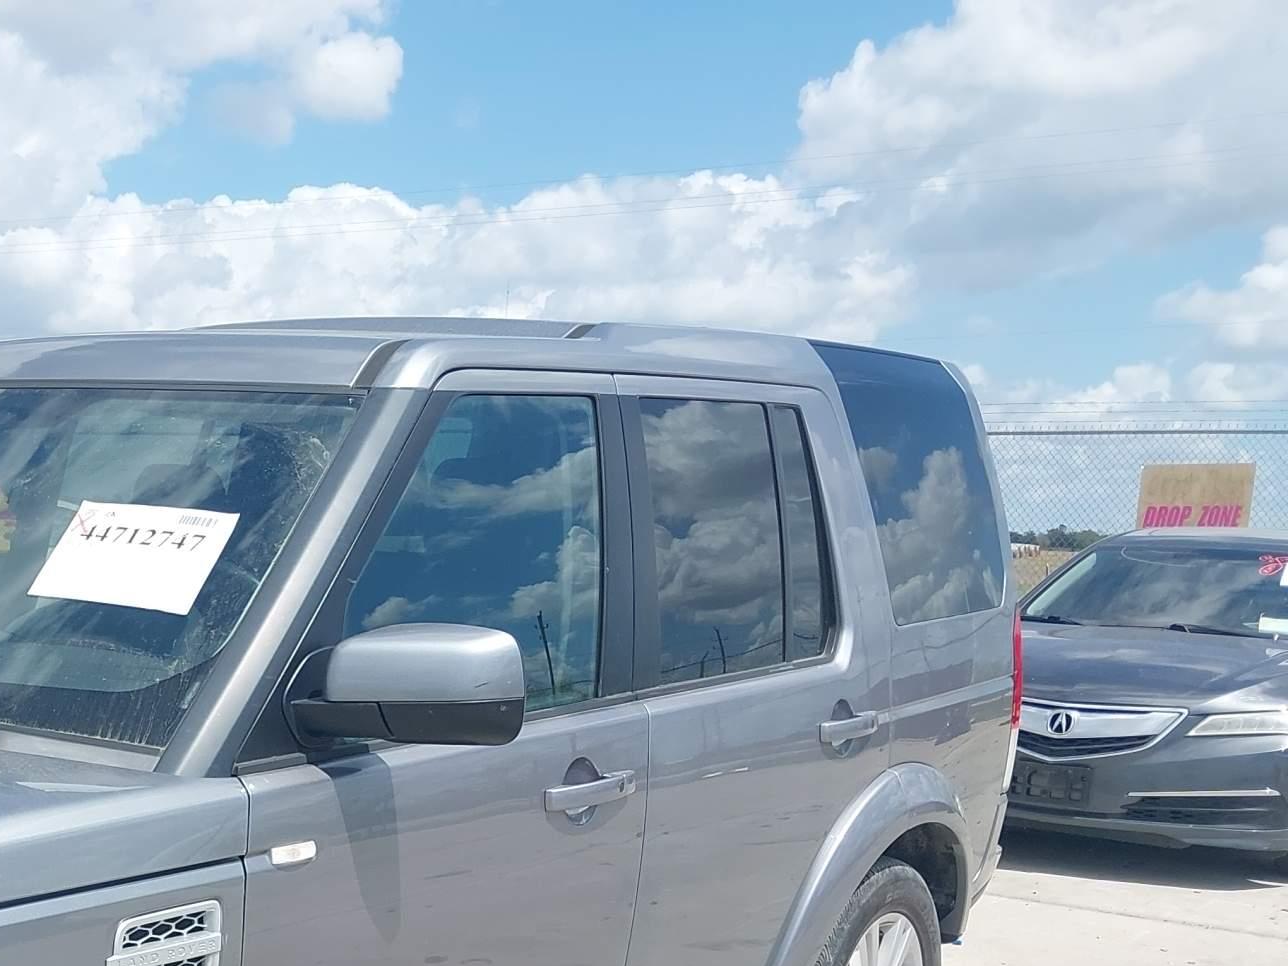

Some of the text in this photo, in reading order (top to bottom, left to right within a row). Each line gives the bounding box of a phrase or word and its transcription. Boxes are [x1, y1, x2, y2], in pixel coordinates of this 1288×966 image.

[1142, 504, 1243, 528] DROP ZONE
[79, 524, 207, 552] 44712747
[167, 938, 217, 961] ROVER
